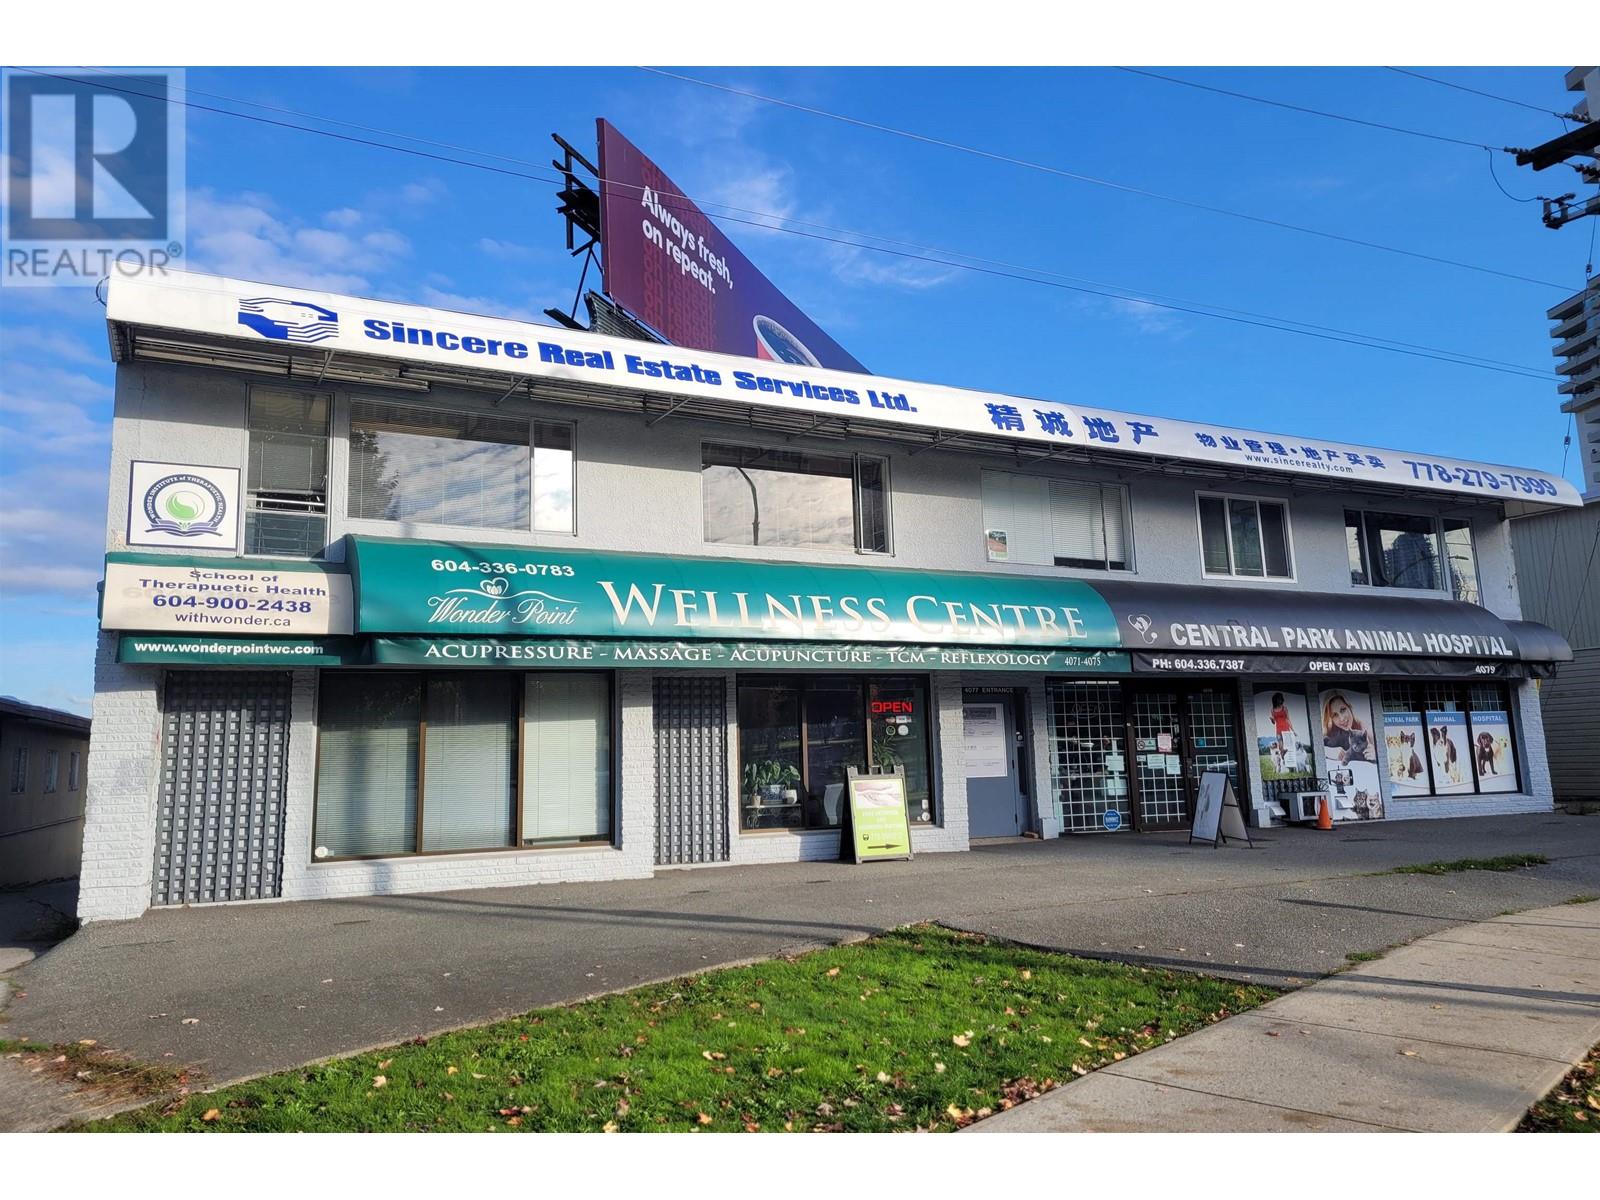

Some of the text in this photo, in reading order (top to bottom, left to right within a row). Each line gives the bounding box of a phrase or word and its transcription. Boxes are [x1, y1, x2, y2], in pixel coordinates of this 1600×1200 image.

[641, 185, 734, 290] Always fresh,
[642, 218, 716, 294] on repeat.
[363, 318, 918, 413] Sincere Real Estate Services Ltd.
[984, 402, 1160, 445] 精诚地产
[1244, 453, 1354, 474] www.sincerealty.com
[150, 476, 178, 496] INSTITUTE
[1402, 460, 1558, 497] 778-279-7999
[189, 569, 279, 583] School of
[431, 559, 575, 577] 604-336-0783
[139, 578, 259, 593] Therapuetic
[266, 584, 327, 597] Health
[152, 594, 312, 614] 604-900-2438
[427, 596, 579, 625] Wonder Point
[596, 580, 1088, 639] WELLNESS CENTRE
[175, 612, 291, 627] withwonder.ca
[134, 641, 324, 656] www.wonderpointwc.com
[1170, 623, 1513, 656] CENTRAL PARK ANIMAL HOSPITAL
[424, 643, 593, 660] ACUPRESSURE
[614, 646, 712, 661] MASSAGE
[729, 648, 872, 663] ACUPUNCTURE
[886, 651, 926, 664] TCM
[941, 652, 1050, 667] REFLEXOLOGY
[1064, 656, 1101, 667] 4071-4075
[1152, 658, 1245, 670] PH: 604.336.7387
[1309, 661, 1371, 672] OPEN 7 DAYS
[1475, 665, 1496, 674] 4079
[871, 702, 912, 713] OPEN
